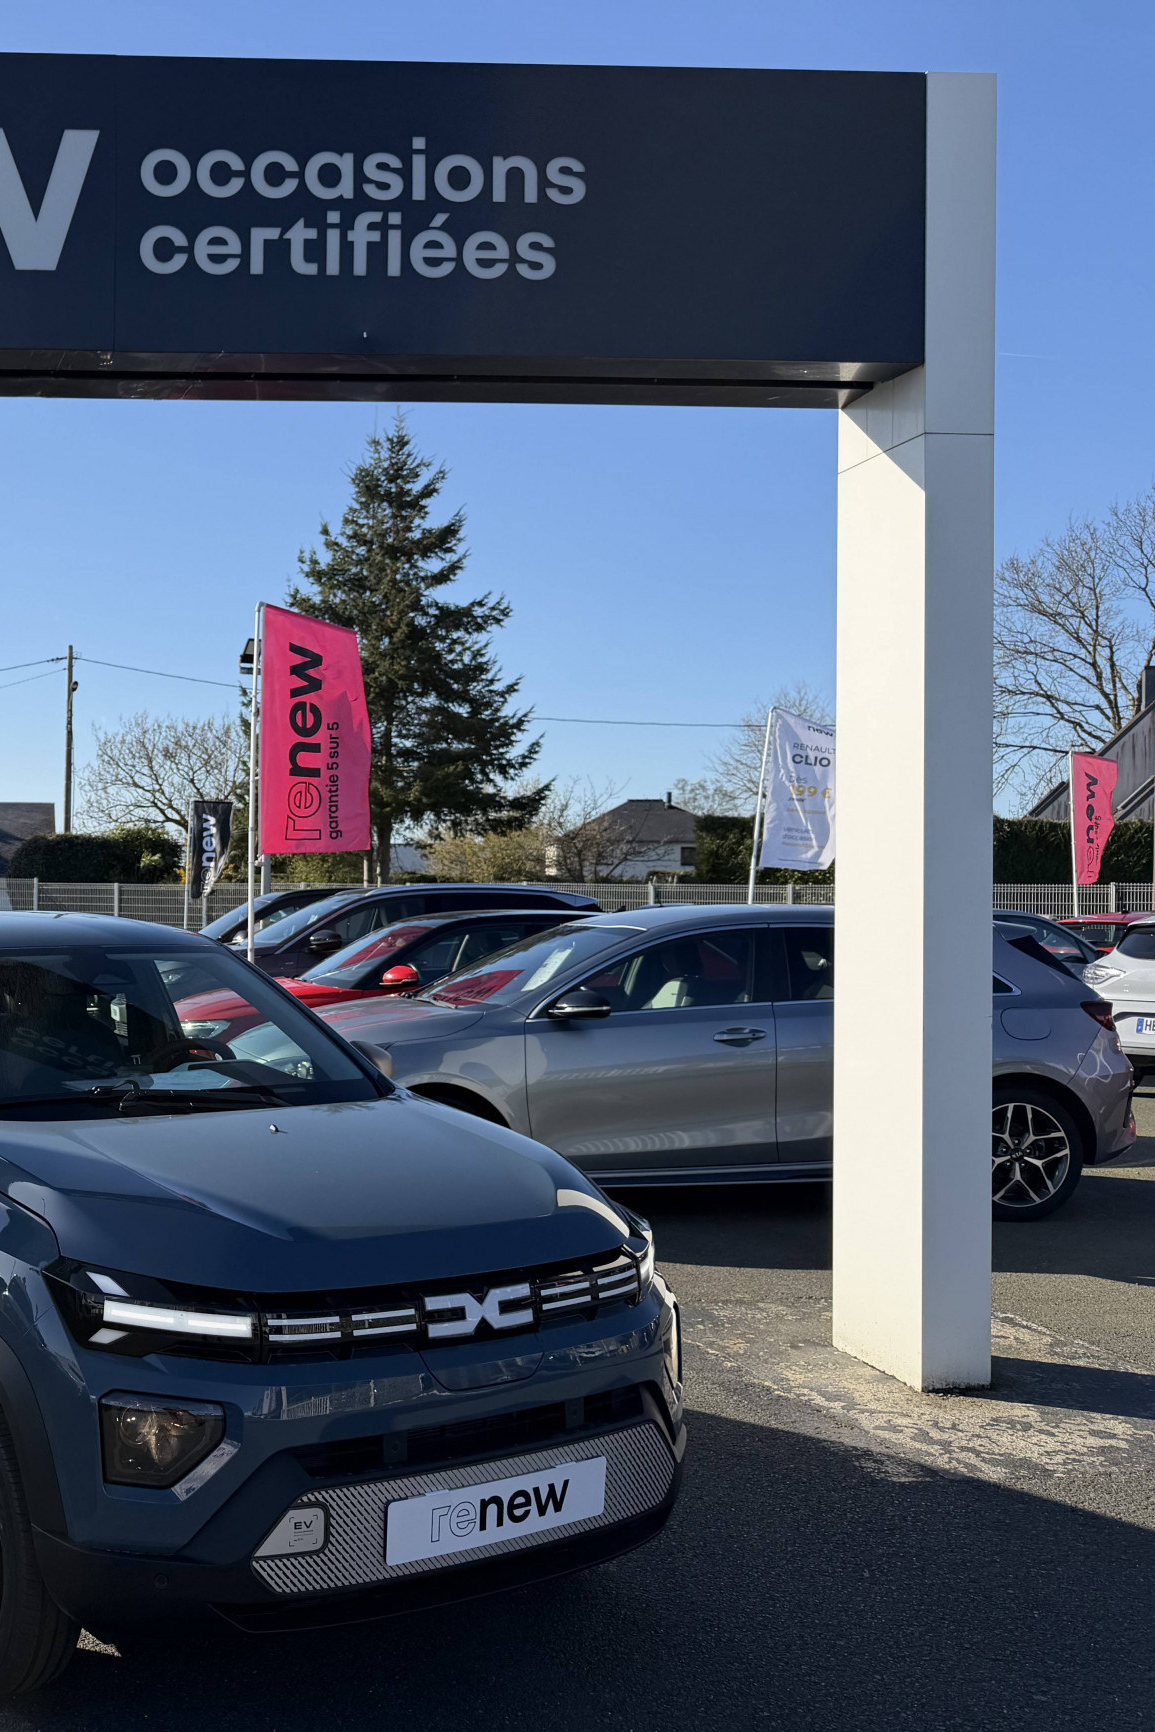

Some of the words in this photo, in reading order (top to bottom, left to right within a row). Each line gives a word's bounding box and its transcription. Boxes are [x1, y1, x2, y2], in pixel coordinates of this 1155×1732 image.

[140, 136, 587, 205] occasions
[139, 210, 557, 281] certifiées
[285, 641, 324, 841] renew
[327, 721, 339, 731] 5
[327, 733, 340, 759] sur
[327, 761, 339, 771] 5
[792, 753, 831, 768] CLIO
[326, 774, 342, 840] garantie
[293, 1520, 313, 1530] EV
[430, 1479, 570, 1543] renew
